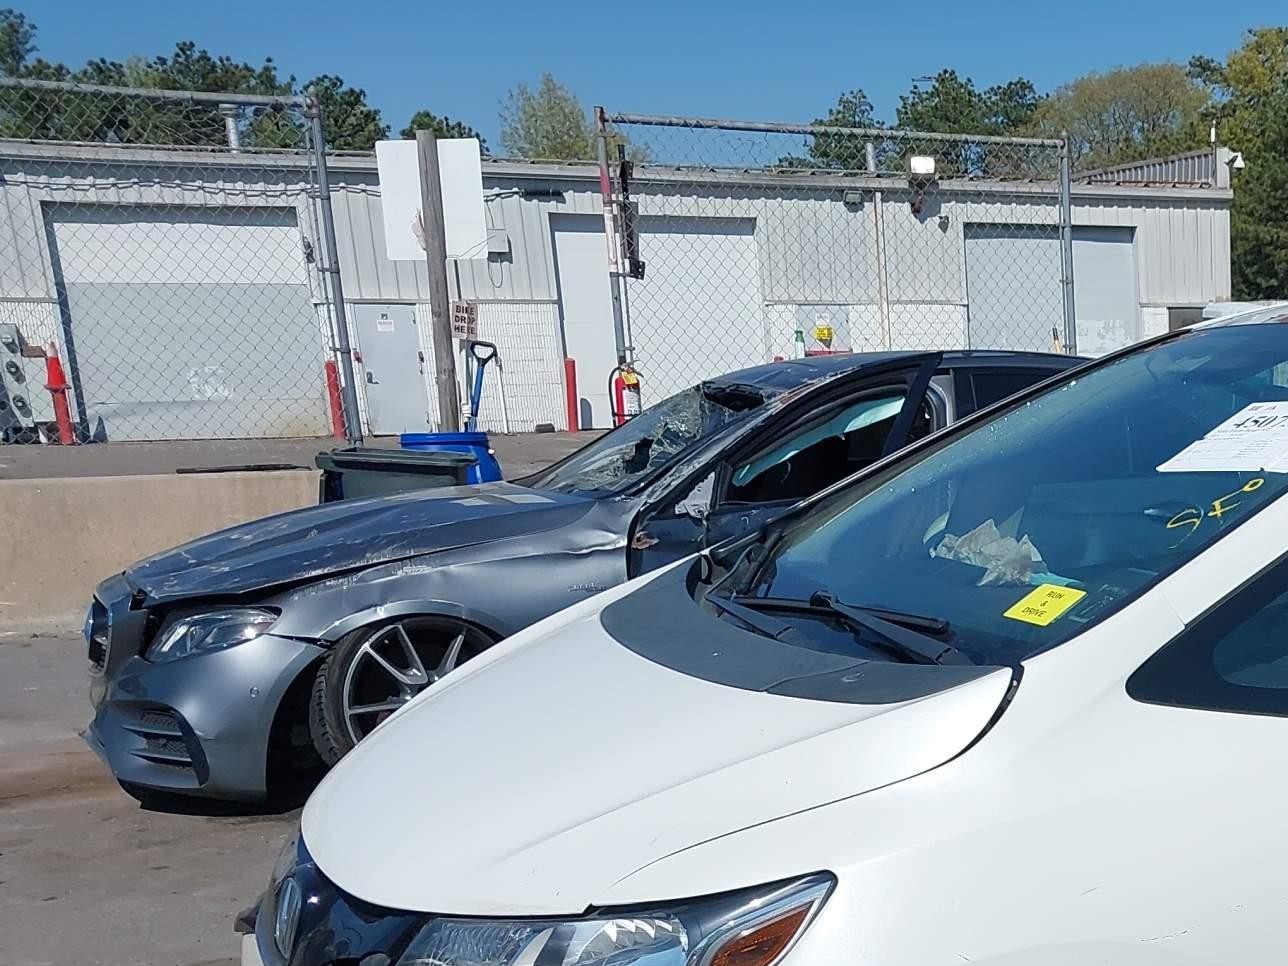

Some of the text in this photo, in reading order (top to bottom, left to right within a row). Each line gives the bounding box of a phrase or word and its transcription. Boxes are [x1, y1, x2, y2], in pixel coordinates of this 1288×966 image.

[455, 304, 475, 315] BIKE
[454, 315, 476, 325] DROP
[454, 325, 476, 334] HERE
[1045, 590, 1065, 600] RUN
[1021, 606, 1047, 618] DRIVE
